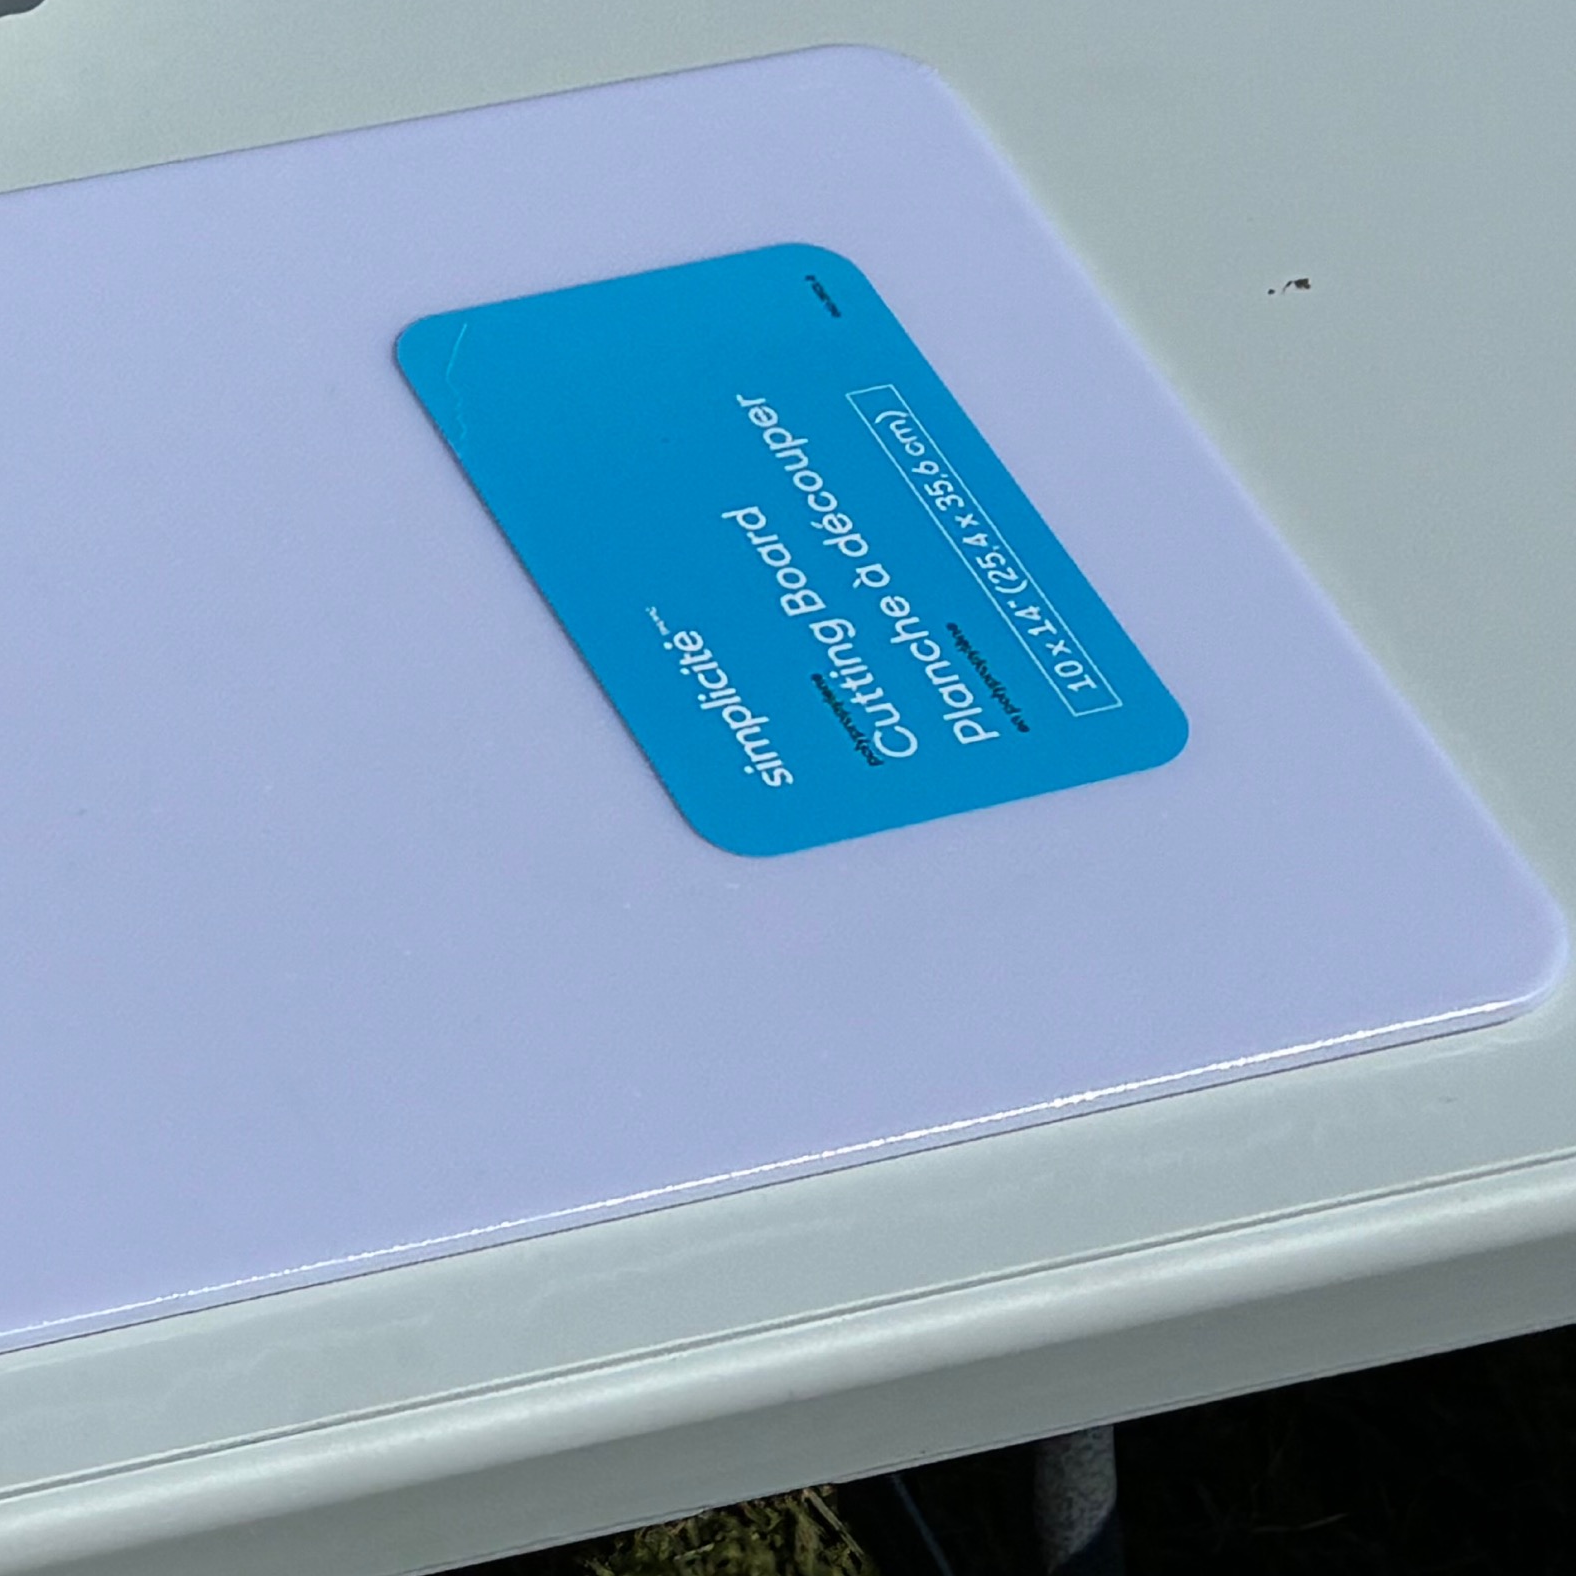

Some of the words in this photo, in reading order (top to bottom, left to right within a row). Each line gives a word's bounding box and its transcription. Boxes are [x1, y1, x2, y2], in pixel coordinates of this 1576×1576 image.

[874, 409, 926, 458] cm)
[736, 394, 870, 559] découper
[912, 460, 966, 512] 35,6
[956, 514, 980, 529] x
[721, 506, 827, 618] Board
[852, 564, 892, 589] à
[963, 532, 1029, 595] (25,4
[880, 595, 1001, 746] Planche
[1045, 640, 1072, 657] x
[1054, 661, 1098, 693] 10
[663, 630, 795, 788] simplicité
[810, 618, 919, 759] Cutting
